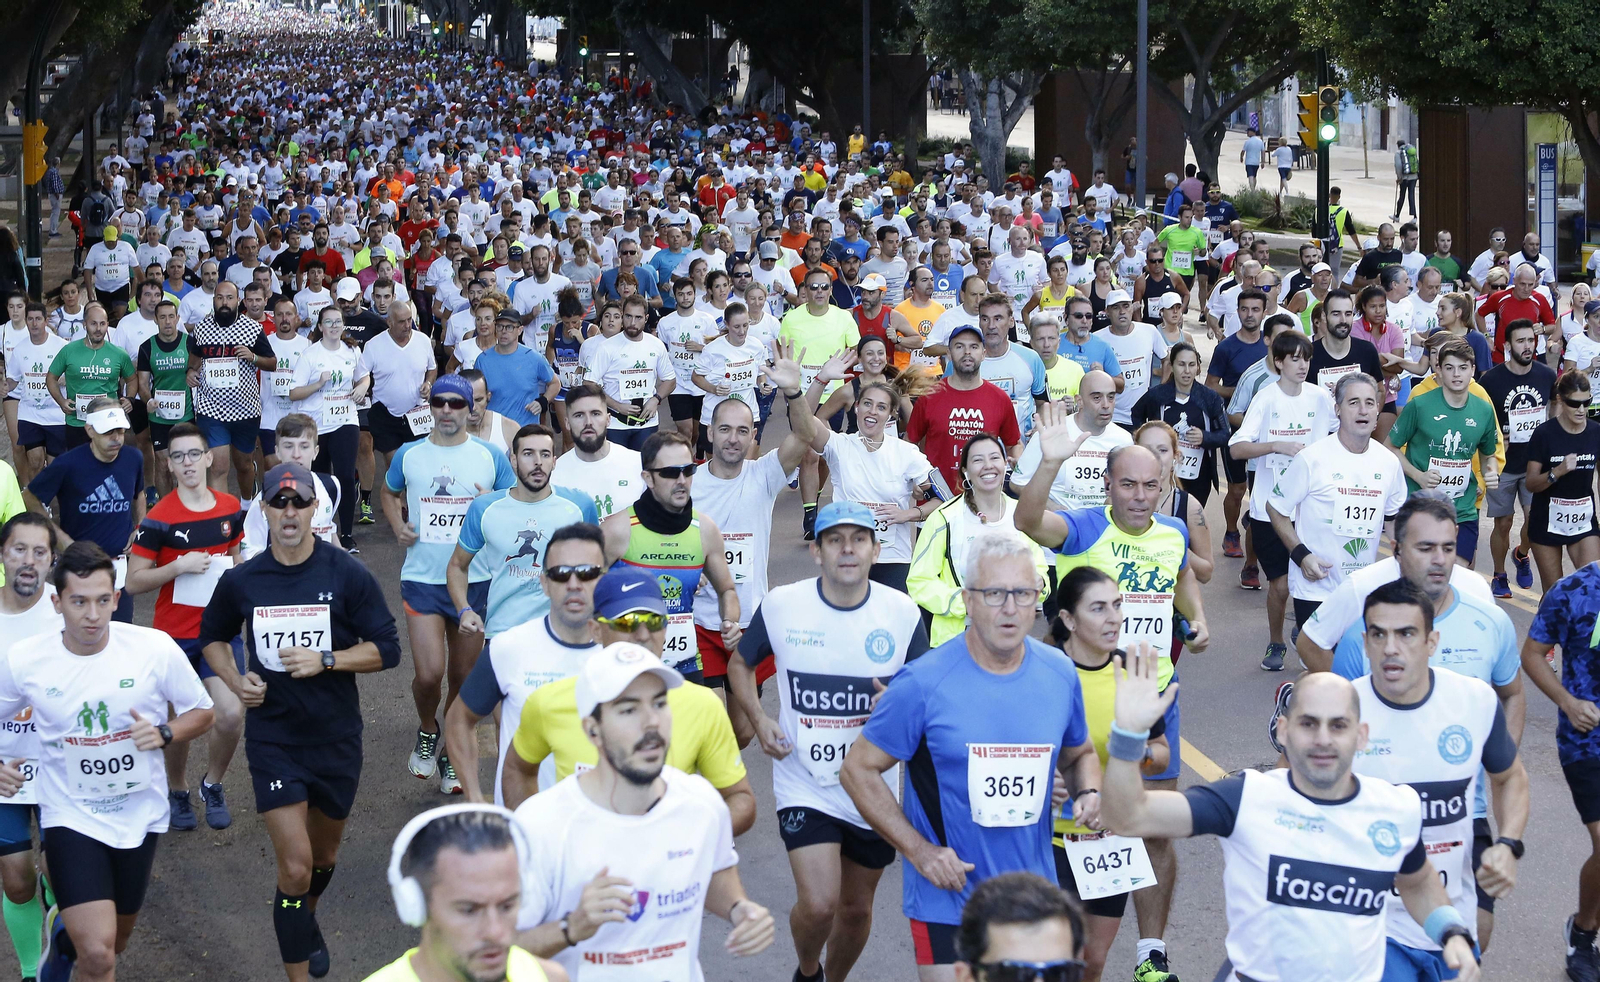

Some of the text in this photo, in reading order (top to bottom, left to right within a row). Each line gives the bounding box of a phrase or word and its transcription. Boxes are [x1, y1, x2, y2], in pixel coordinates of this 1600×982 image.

[1540, 148, 1555, 159] BUS
[156, 356, 186, 366] mijas
[674, 352, 694, 360] 2484
[80, 364, 112, 376] mijas
[208, 368, 237, 378] 18838
[732, 370, 752, 381] 3534
[625, 379, 647, 389] 2941
[159, 401, 181, 410] 6468
[330, 406, 349, 415] 1231
[413, 414, 432, 426] 9003
[949, 420, 984, 428] MARATÓN
[1516, 420, 1540, 432] 2626
[1075, 466, 1108, 480] 3954
[79, 500, 130, 514] adidas
[1344, 506, 1376, 520] 1317
[429, 513, 465, 526] 2677
[1556, 512, 1586, 523] 2184
[1112, 542, 1130, 559] VII
[256, 610, 268, 618] 41
[1123, 617, 1163, 634] 1770
[262, 630, 324, 649] 17157
[662, 636, 688, 651] 45
[972, 747, 987, 758] 41
[80, 754, 134, 775] 6909
[984, 776, 1035, 797] 3651
[1083, 847, 1132, 874] 6437
[584, 953, 603, 964] 41
